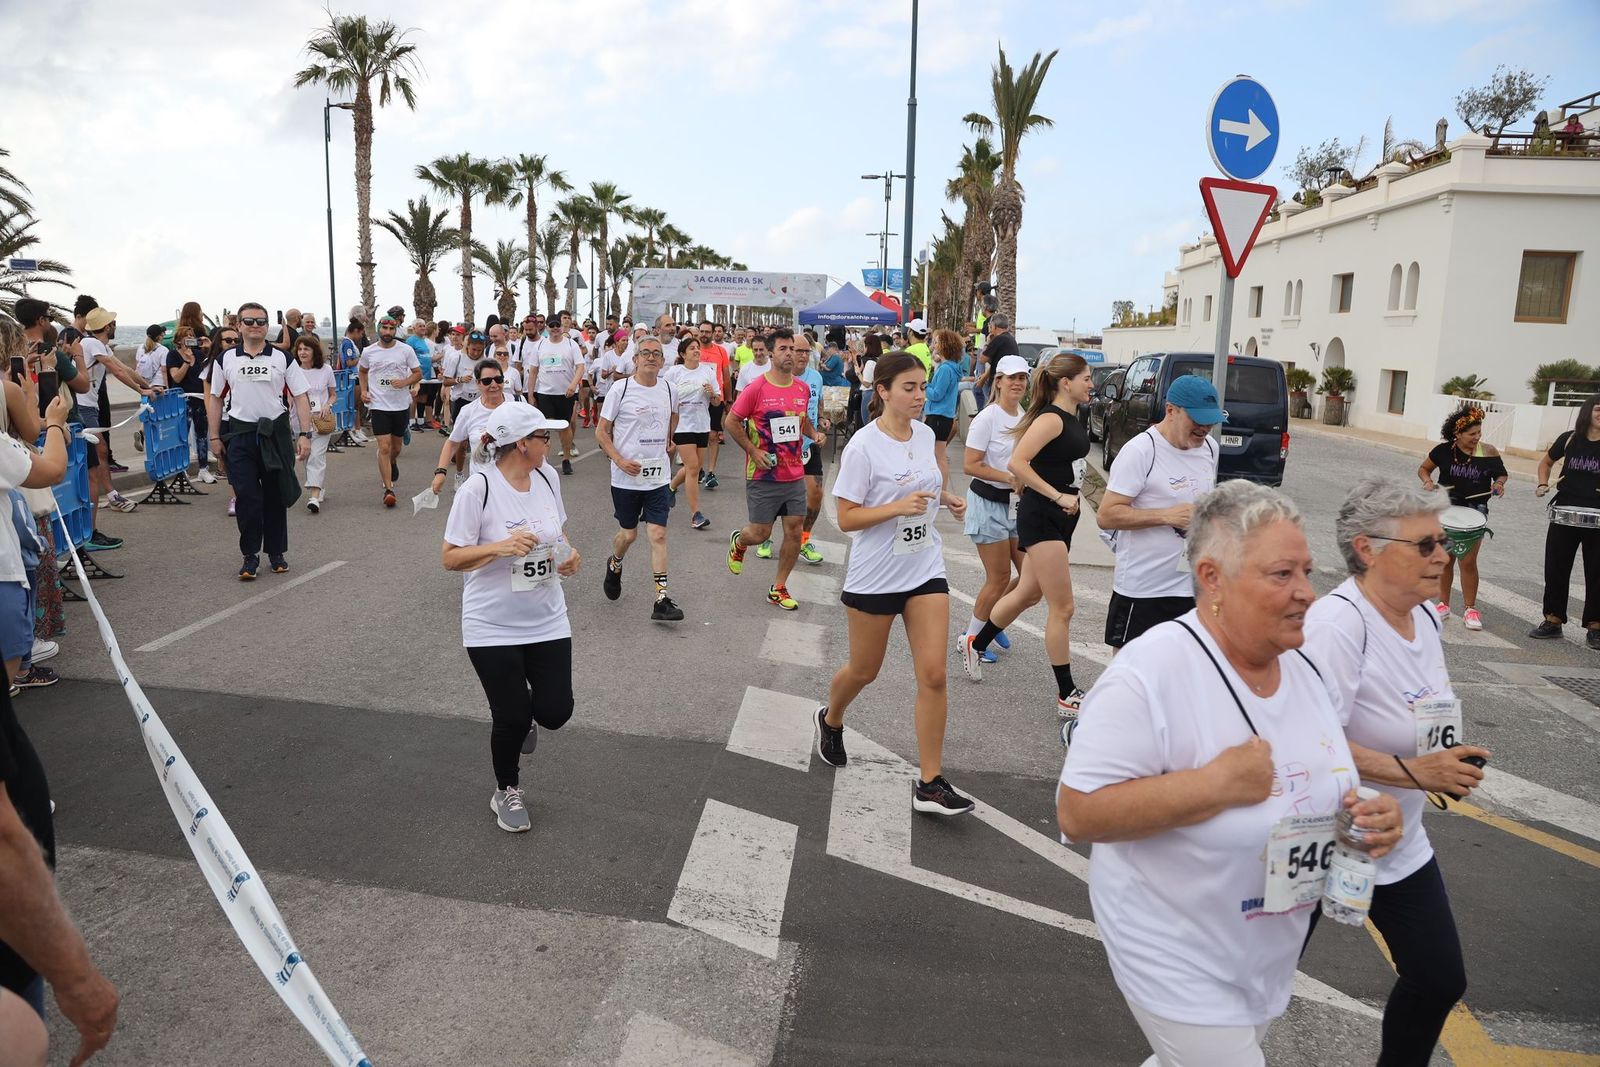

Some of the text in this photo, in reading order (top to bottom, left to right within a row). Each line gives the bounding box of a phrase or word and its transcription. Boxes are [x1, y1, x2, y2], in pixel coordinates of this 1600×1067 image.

[694, 275, 764, 285] 3A CARRERA 5K
[240, 366, 269, 375] 1282
[380, 378, 392, 386] 26
[778, 425, 796, 435] 541
[642, 466, 662, 477] 577
[902, 523, 927, 542] 358
[1287, 840, 1337, 880] 546
[1241, 897, 1265, 912] DONA
